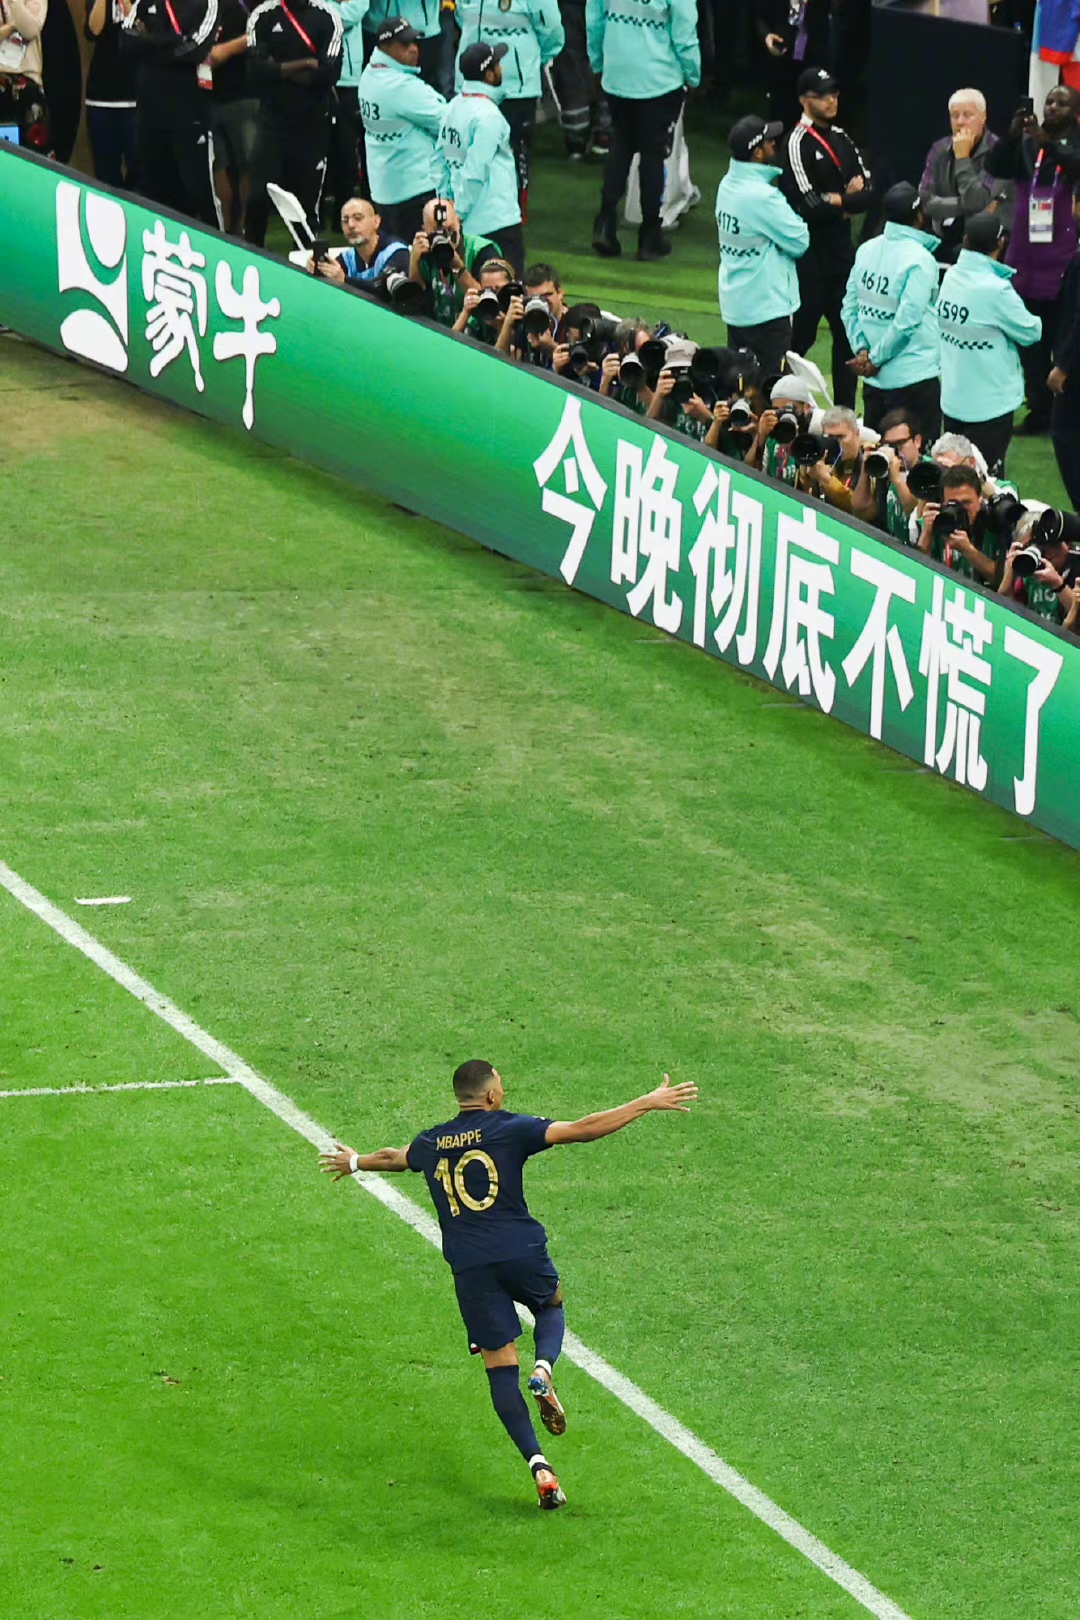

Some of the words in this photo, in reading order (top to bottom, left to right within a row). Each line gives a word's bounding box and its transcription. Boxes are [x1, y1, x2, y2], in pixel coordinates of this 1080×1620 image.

[861, 270, 889, 295] 4612
[141, 218, 282, 430] 蒙牛
[532, 394, 1064, 816] 今晚彻底不慌了
[436, 1128, 483, 1150] MBAPPE
[433, 1148, 499, 1217] 10
